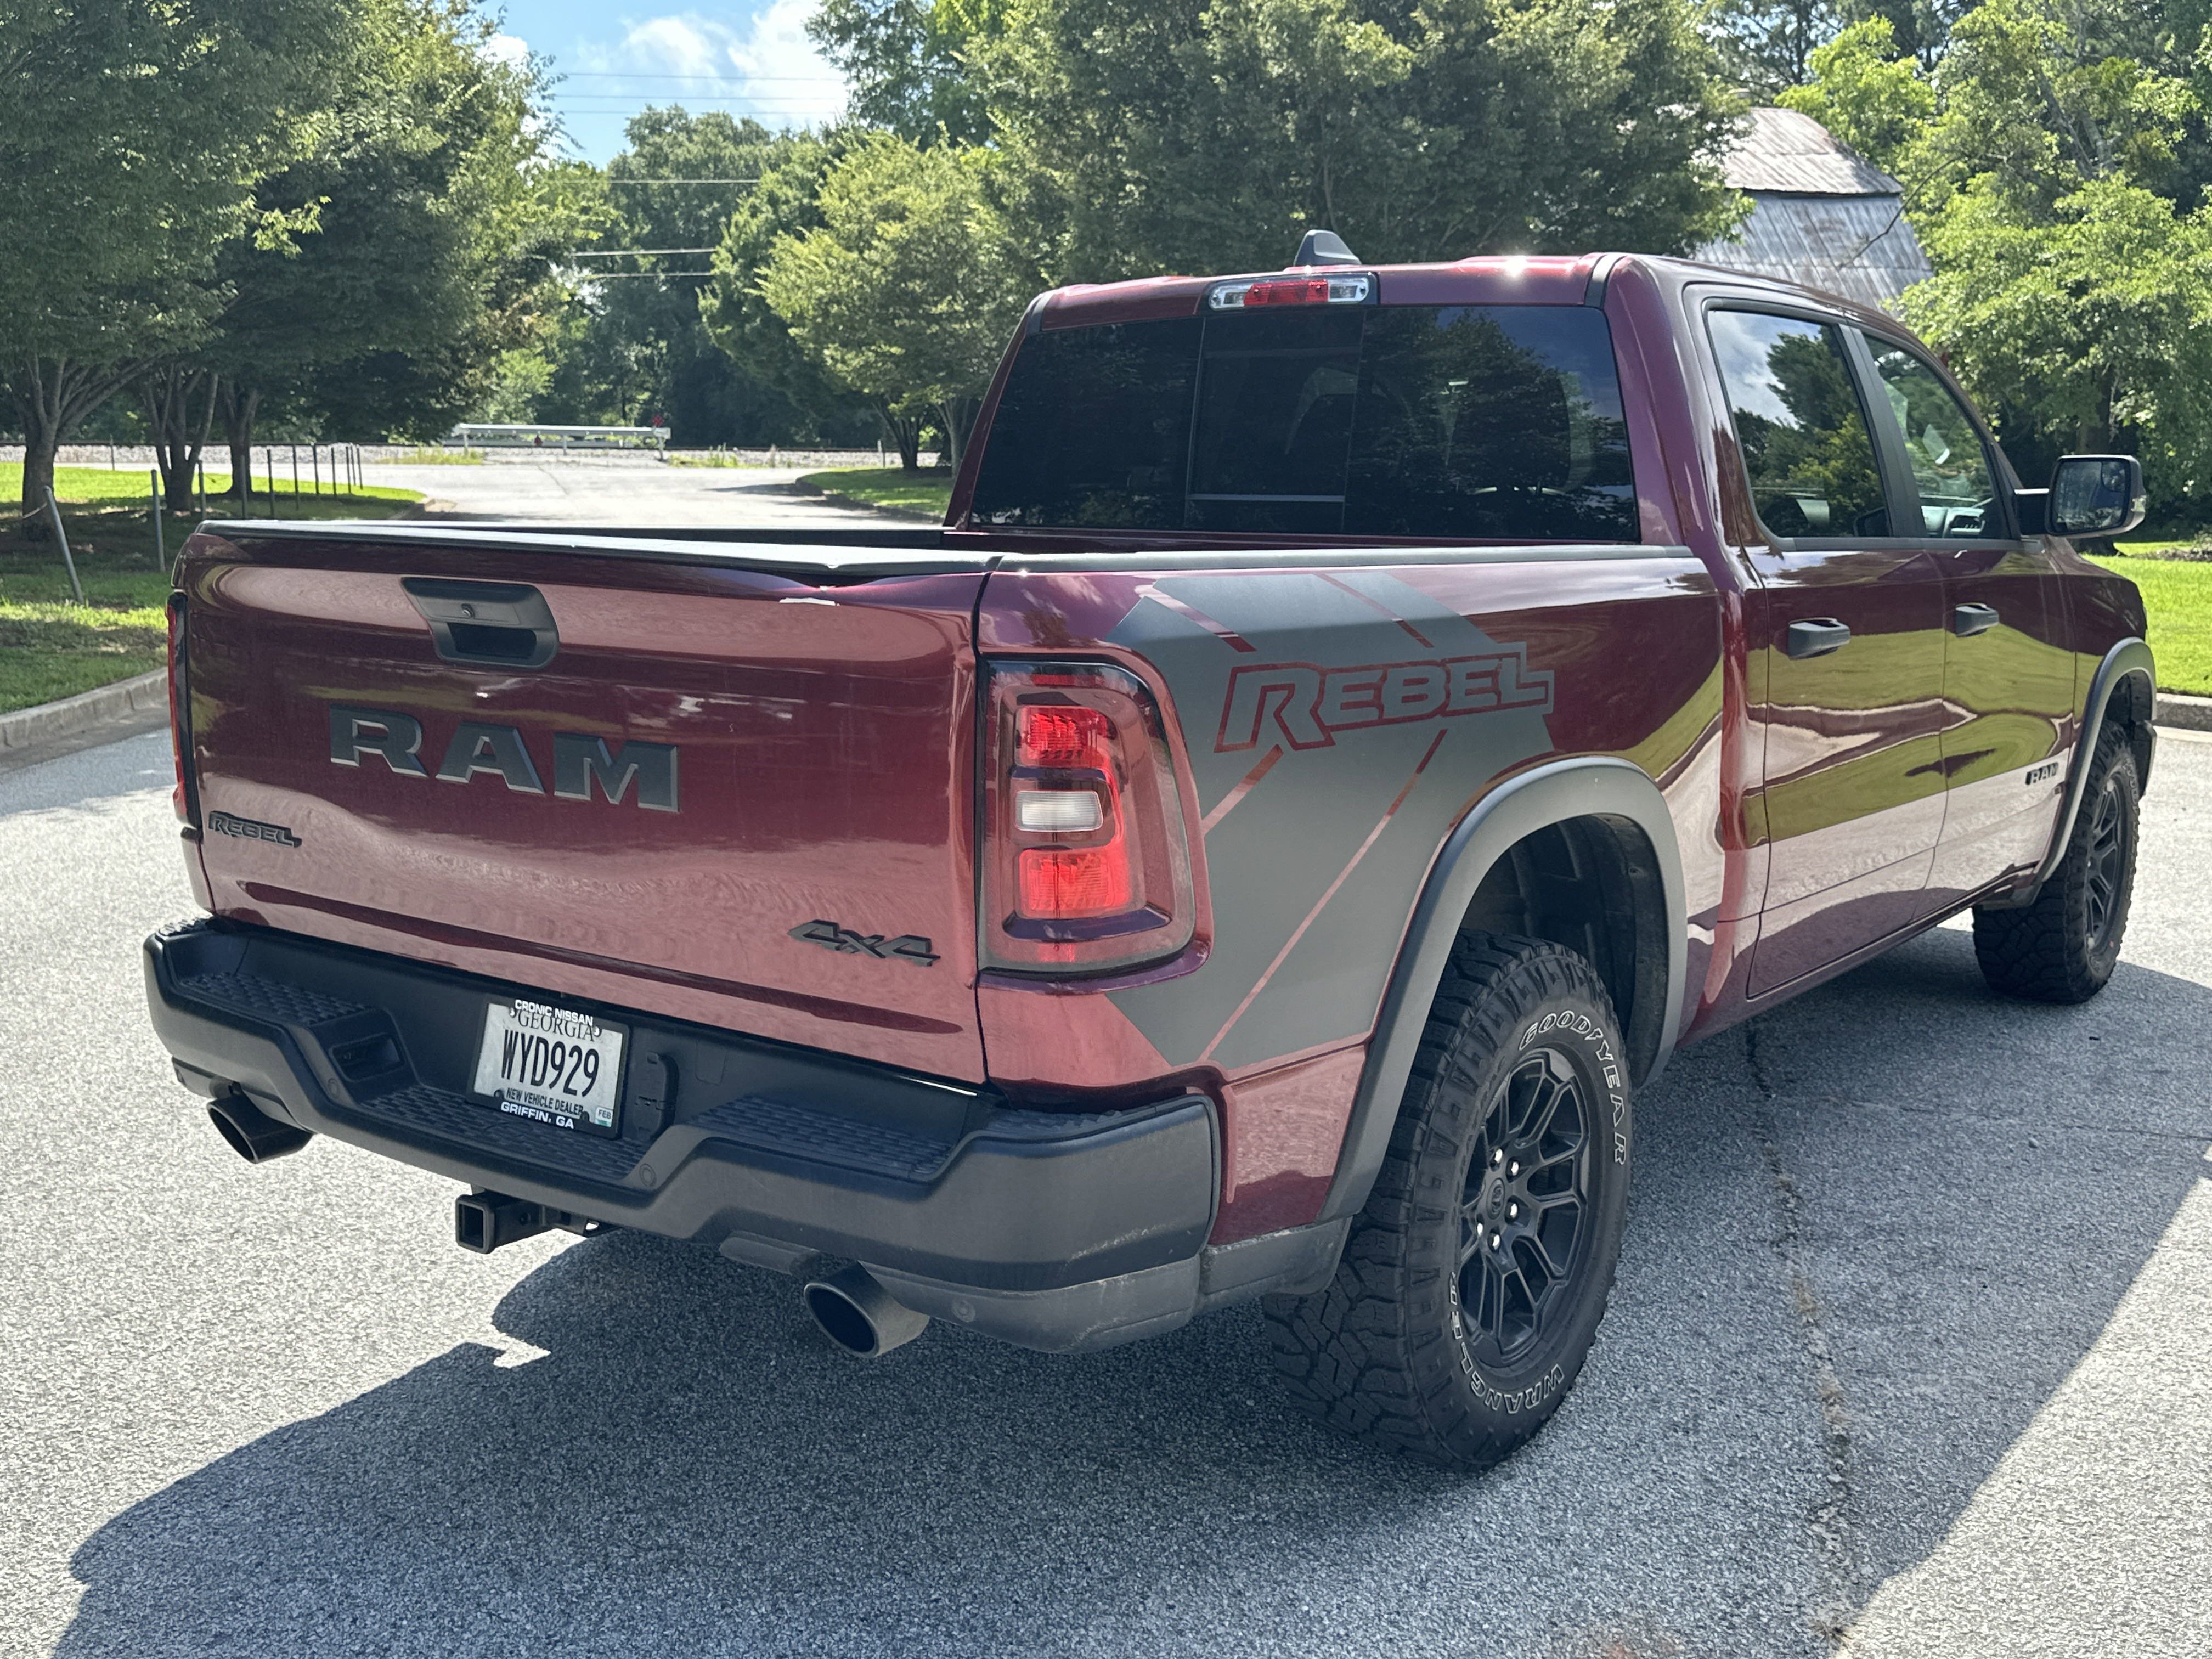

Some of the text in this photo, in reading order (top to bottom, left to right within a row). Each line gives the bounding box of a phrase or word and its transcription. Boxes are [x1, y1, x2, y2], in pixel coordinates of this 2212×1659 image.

[1214, 651, 1549, 753] REBEL
[329, 703, 680, 813] RAM
[208, 810, 302, 848] REBEL
[515, 999, 593, 1026] CRONIC NISSAN
[518, 1011, 595, 1042] GEORGIA
[501, 1029, 599, 1097] WYD929
[506, 1087, 583, 1116] NEW VEHICLE DEALER
[598, 1109, 611, 1119] FEB
[556, 1116, 574, 1129] GA
[1449, 1271, 1565, 1414] WRANGLER
